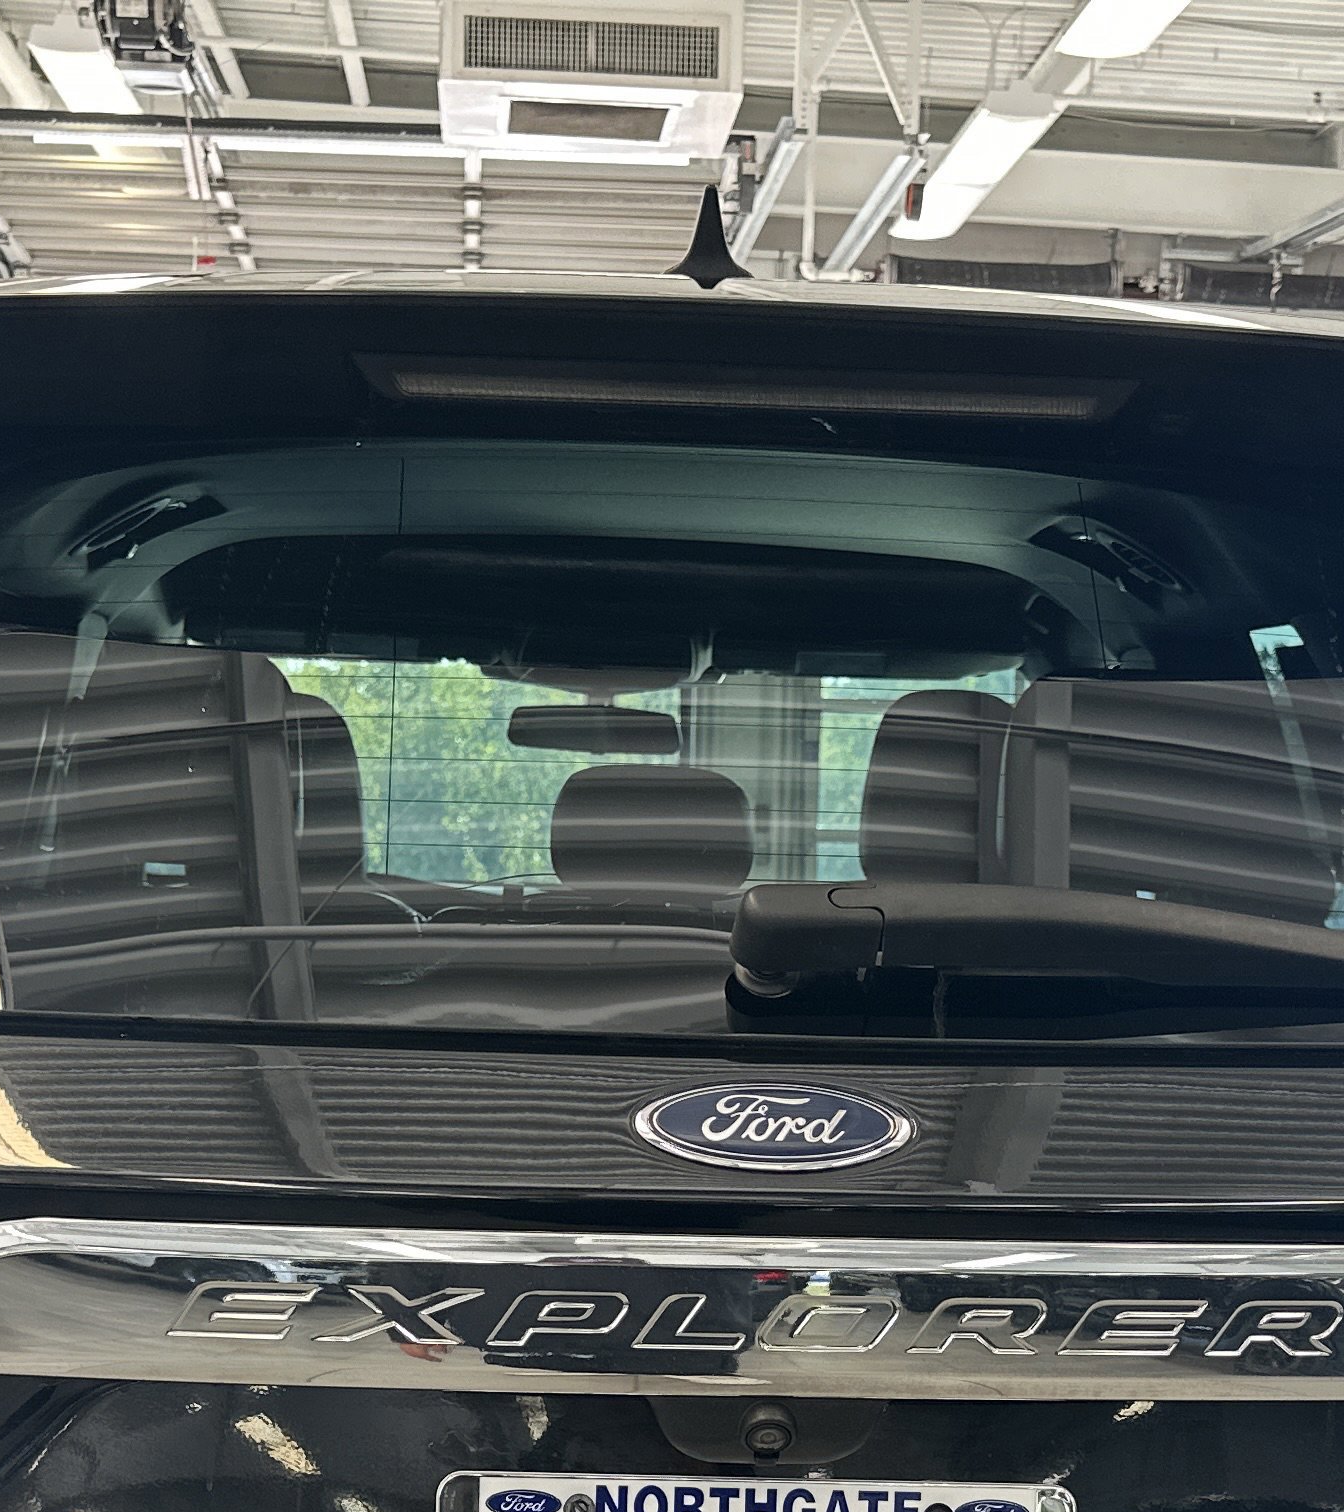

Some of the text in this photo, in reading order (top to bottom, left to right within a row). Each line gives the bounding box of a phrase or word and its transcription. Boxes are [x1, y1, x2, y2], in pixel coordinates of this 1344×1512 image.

[701, 1094, 847, 1144] Ford
[166, 1280, 1344, 1357] EXPLORER
[500, 1493, 547, 1512] Ford
